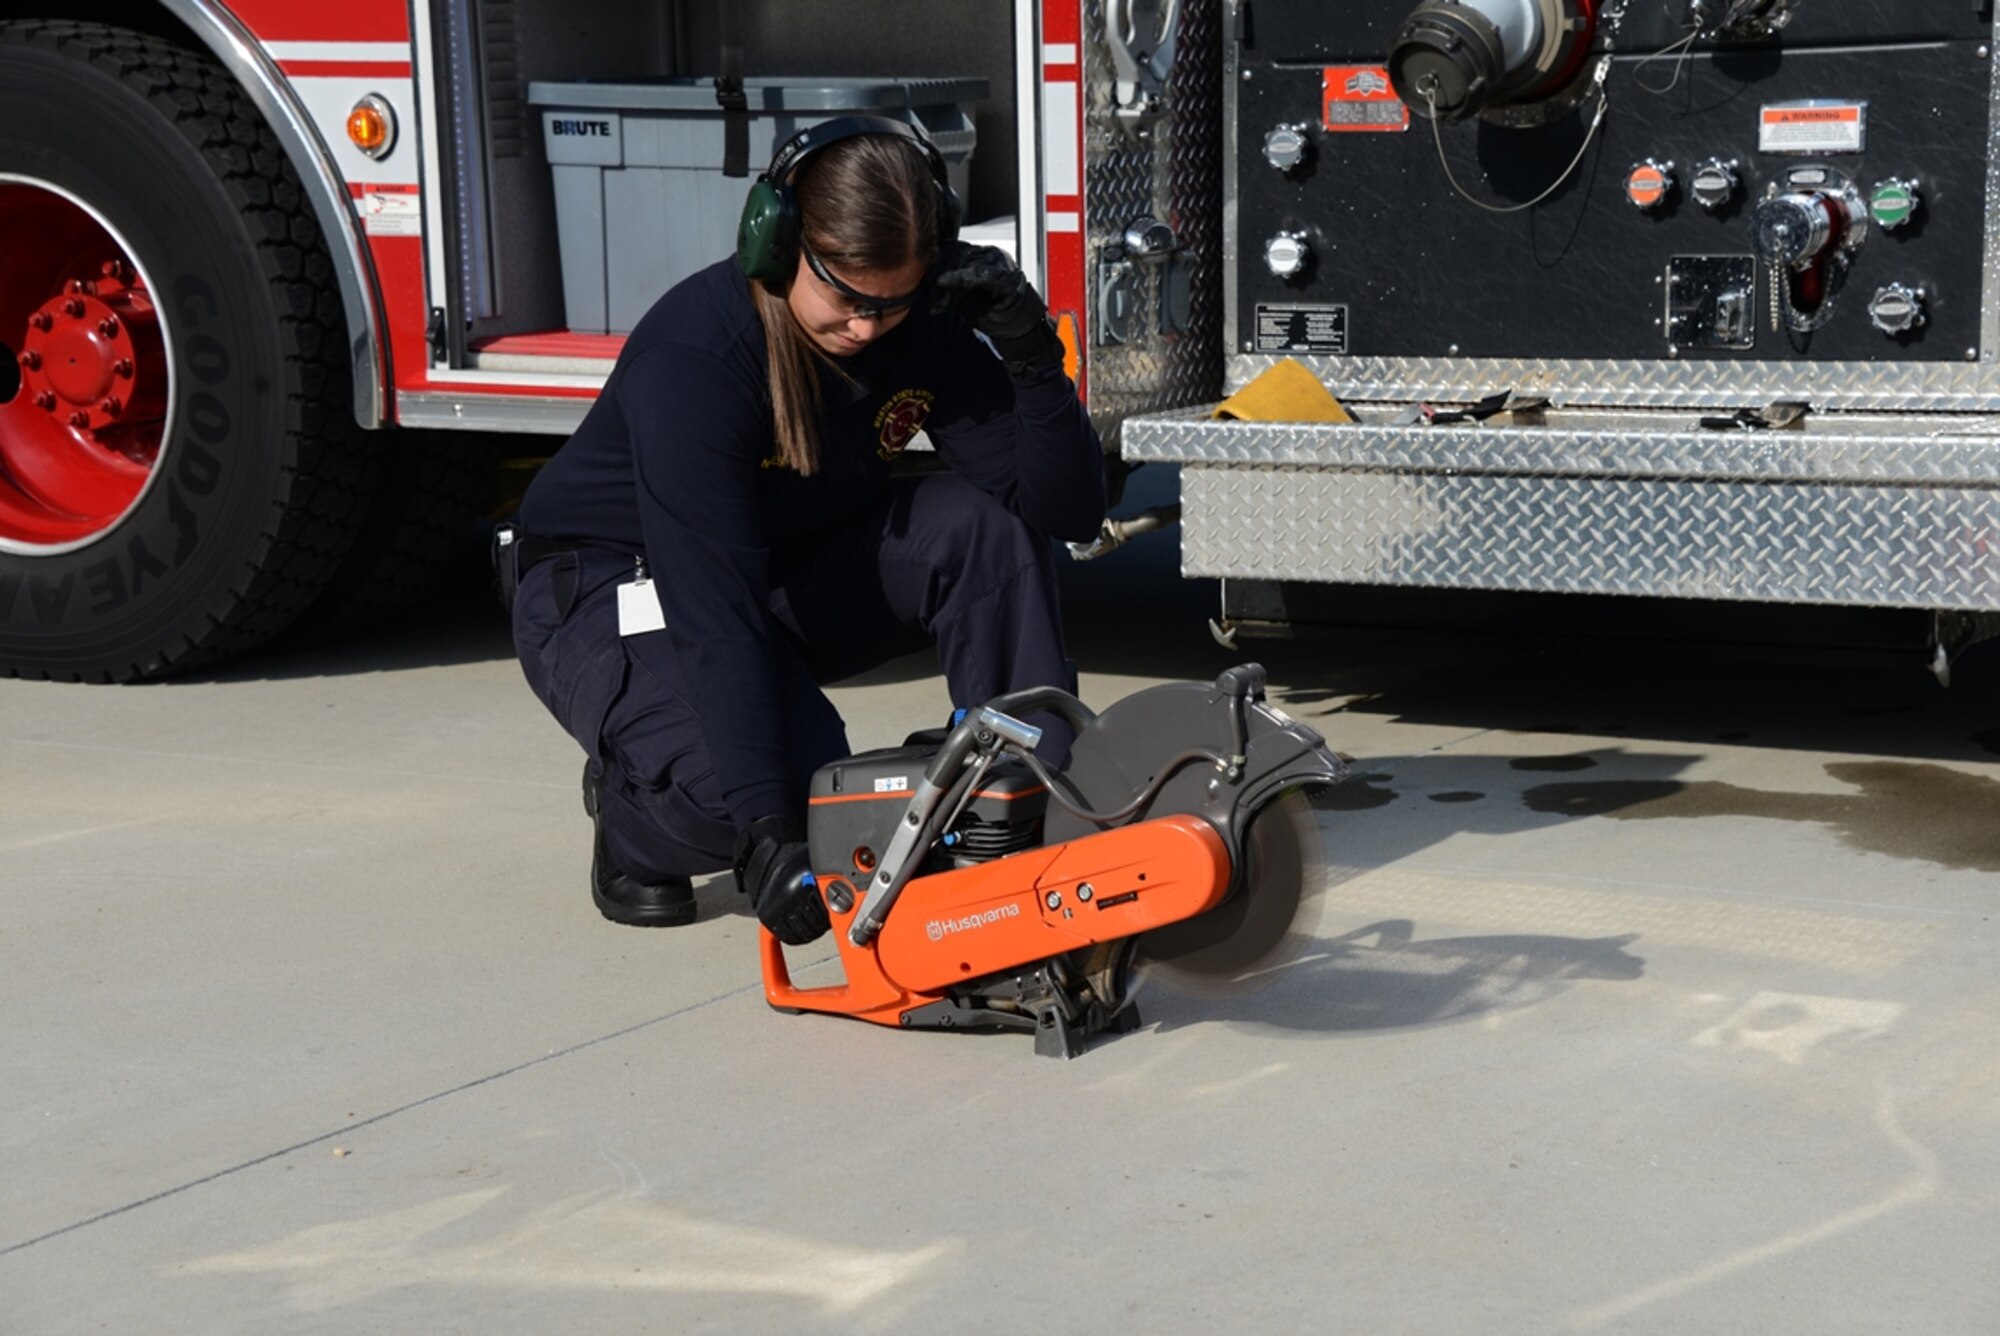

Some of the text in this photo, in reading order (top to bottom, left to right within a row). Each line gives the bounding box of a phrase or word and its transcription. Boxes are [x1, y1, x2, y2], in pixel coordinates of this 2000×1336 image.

[1792, 111, 1840, 121] WARNING
[552, 119, 611, 136] BRUTE
[941, 903, 1020, 935] Husqvarna
